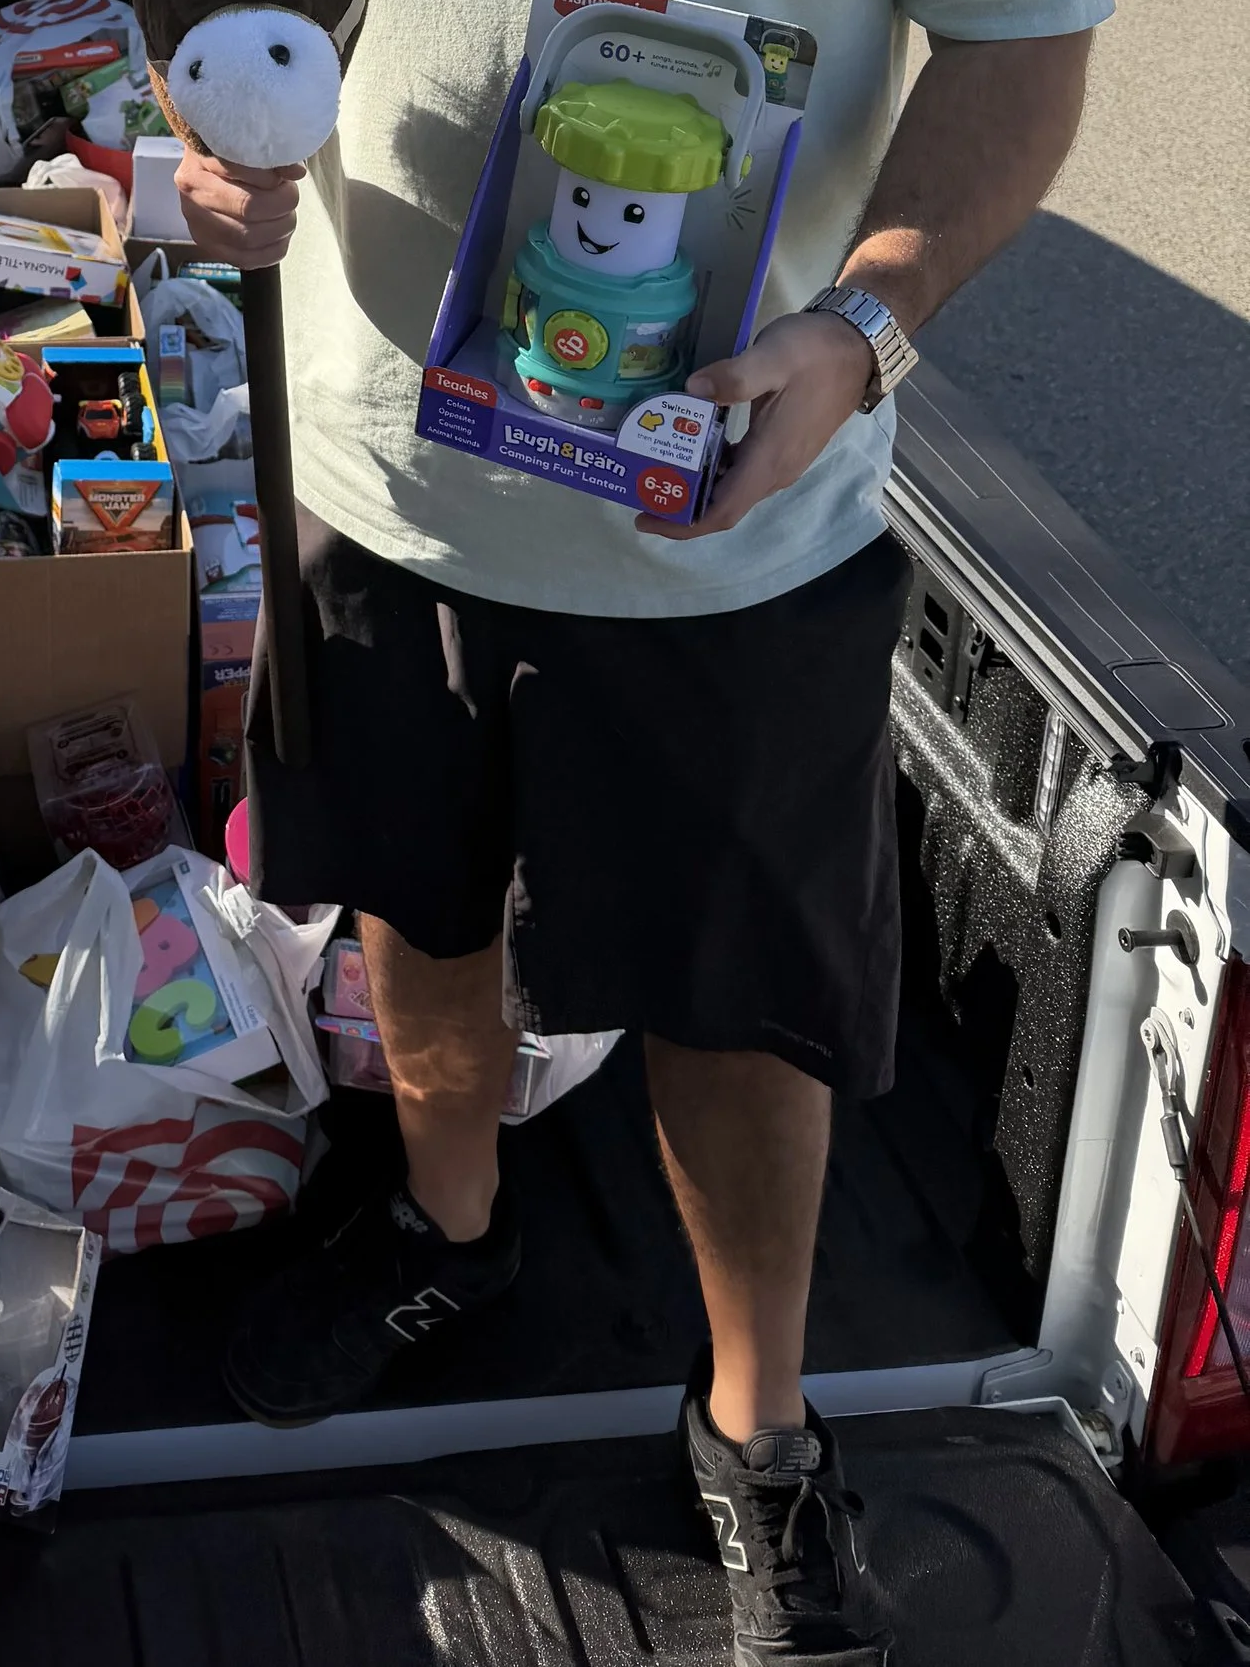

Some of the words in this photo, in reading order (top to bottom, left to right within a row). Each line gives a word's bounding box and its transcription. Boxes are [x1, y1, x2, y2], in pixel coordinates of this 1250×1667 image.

[599, 40, 645, 63] 60+
[435, 373, 489, 400] Teaches
[446, 399, 471, 412] Colors
[661, 401, 691, 416] Switch
[693, 411, 705, 420] on
[438, 407, 476, 425] Opposites
[438, 418, 472, 435] Counting
[427, 425, 453, 439] Animal
[454, 433, 481, 448] sounds
[504, 425, 626, 477] Laugh&Learn
[653, 438, 671, 449] push
[672, 442, 694, 454] down
[499, 445, 550, 471] Camping
[582, 471, 627, 494] Lantern
[644, 476, 684, 499] 6-36
[88, 494, 145, 503] MONSTER
[105, 502, 130, 511] JAM
[654, 494, 668, 506] m
